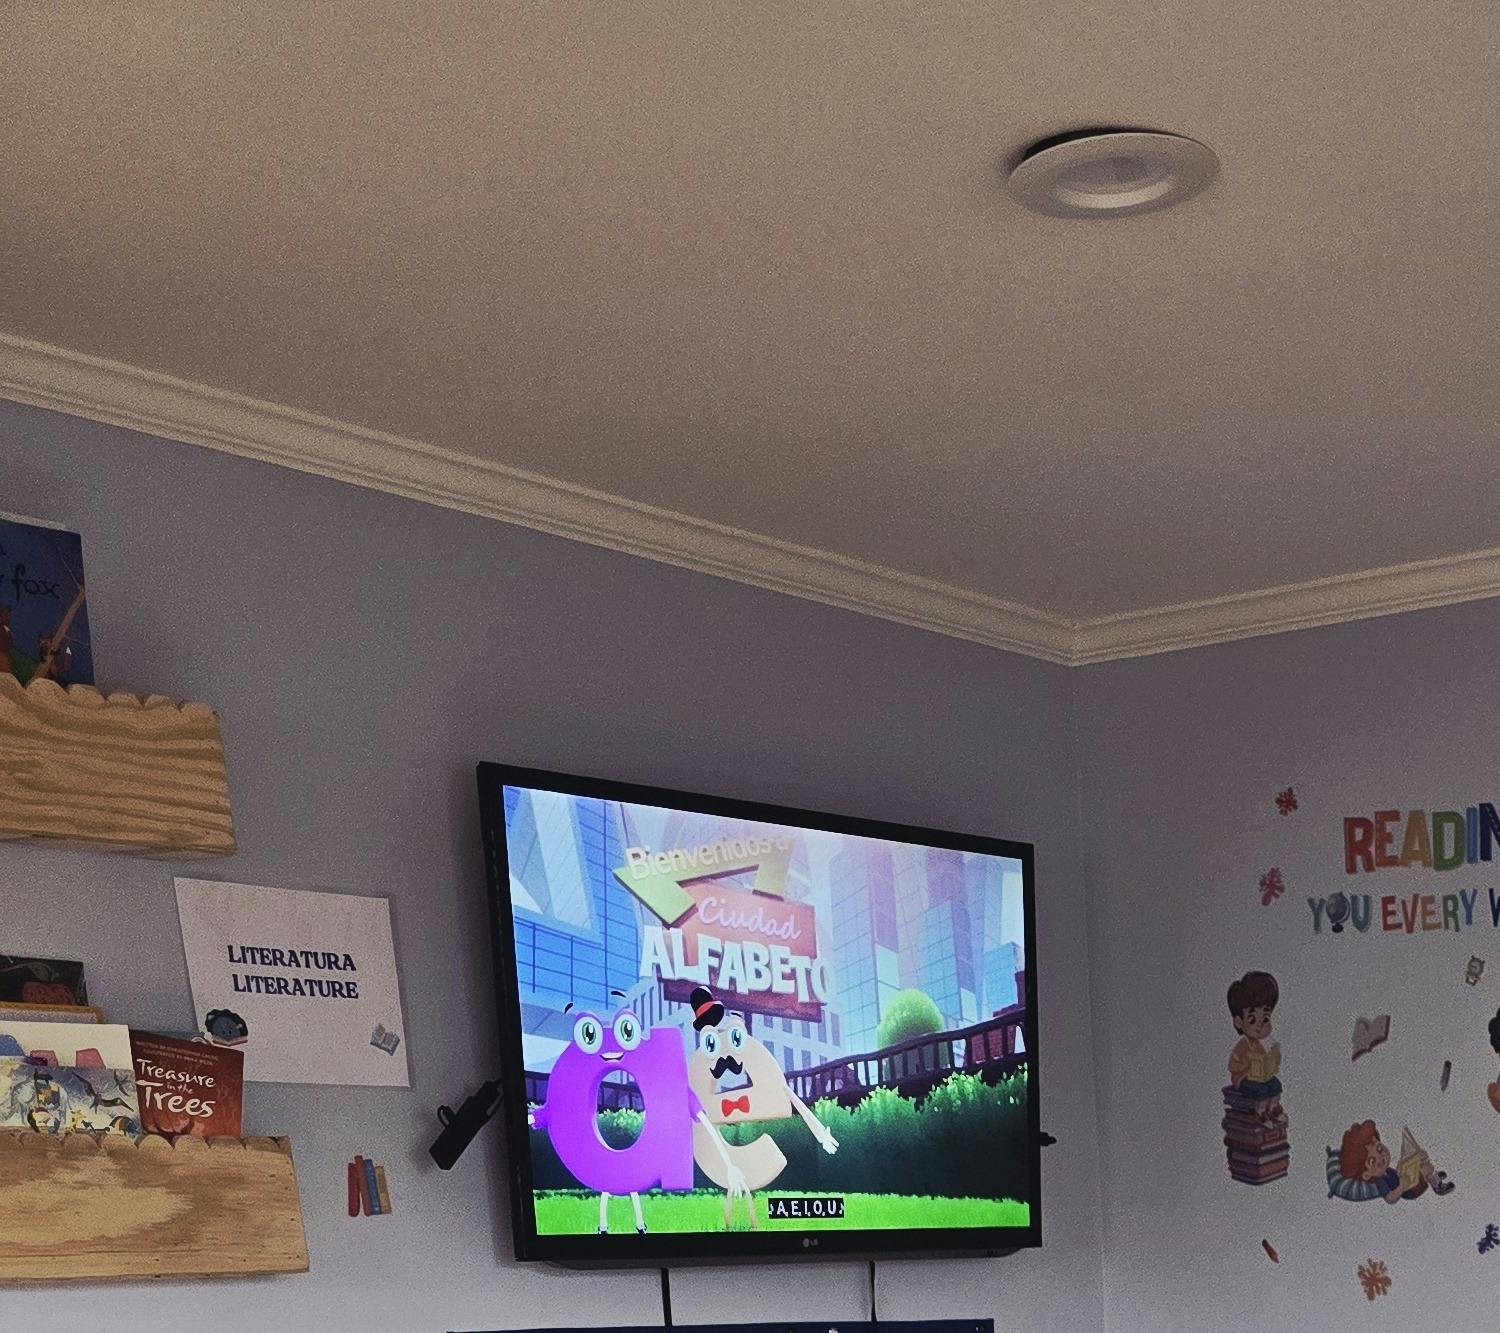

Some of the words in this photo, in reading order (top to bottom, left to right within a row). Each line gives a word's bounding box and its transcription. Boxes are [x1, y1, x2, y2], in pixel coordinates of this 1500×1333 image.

[625, 834, 773, 881] Bienvenidos
[698, 896, 801, 940] Ciudad
[1380, 888, 1478, 934] EVERY
[227, 945, 357, 971] LITERATURA
[638, 924, 834, 1003] ALFABETO
[232, 974, 359, 999] LITERATURE
[136, 1058, 216, 1088] Treasure
[136, 1080, 216, 1118] Trees
